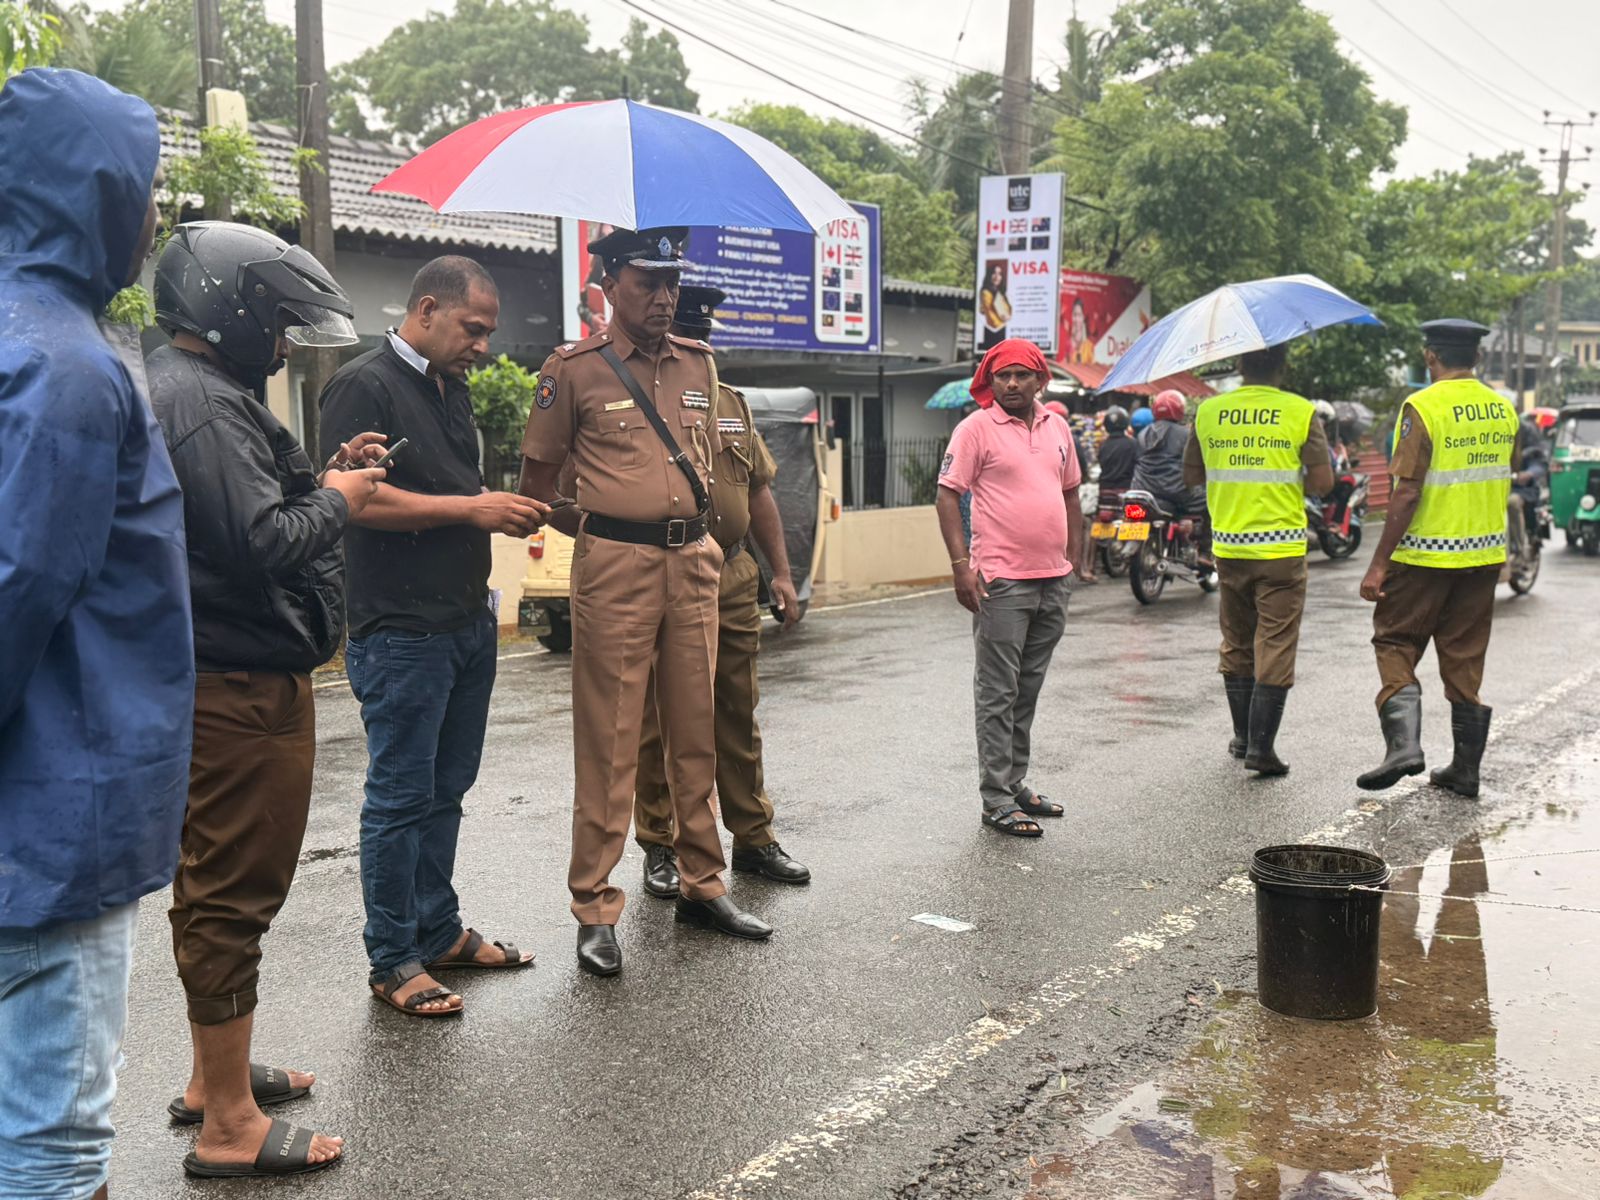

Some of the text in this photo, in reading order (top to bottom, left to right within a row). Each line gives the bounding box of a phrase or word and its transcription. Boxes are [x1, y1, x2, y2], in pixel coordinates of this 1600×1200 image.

[1009, 184, 1030, 198] utc
[827, 219, 860, 240] VISA
[1011, 260, 1049, 275] VISA
[1218, 408, 1282, 426] POLICE
[1452, 402, 1507, 423] POLICE
[1208, 436, 1292, 449] Scene Of Crime
[1479, 432, 1490, 445] Of
[1229, 454, 1266, 466] Officer
[1467, 451, 1500, 465] Offcer
